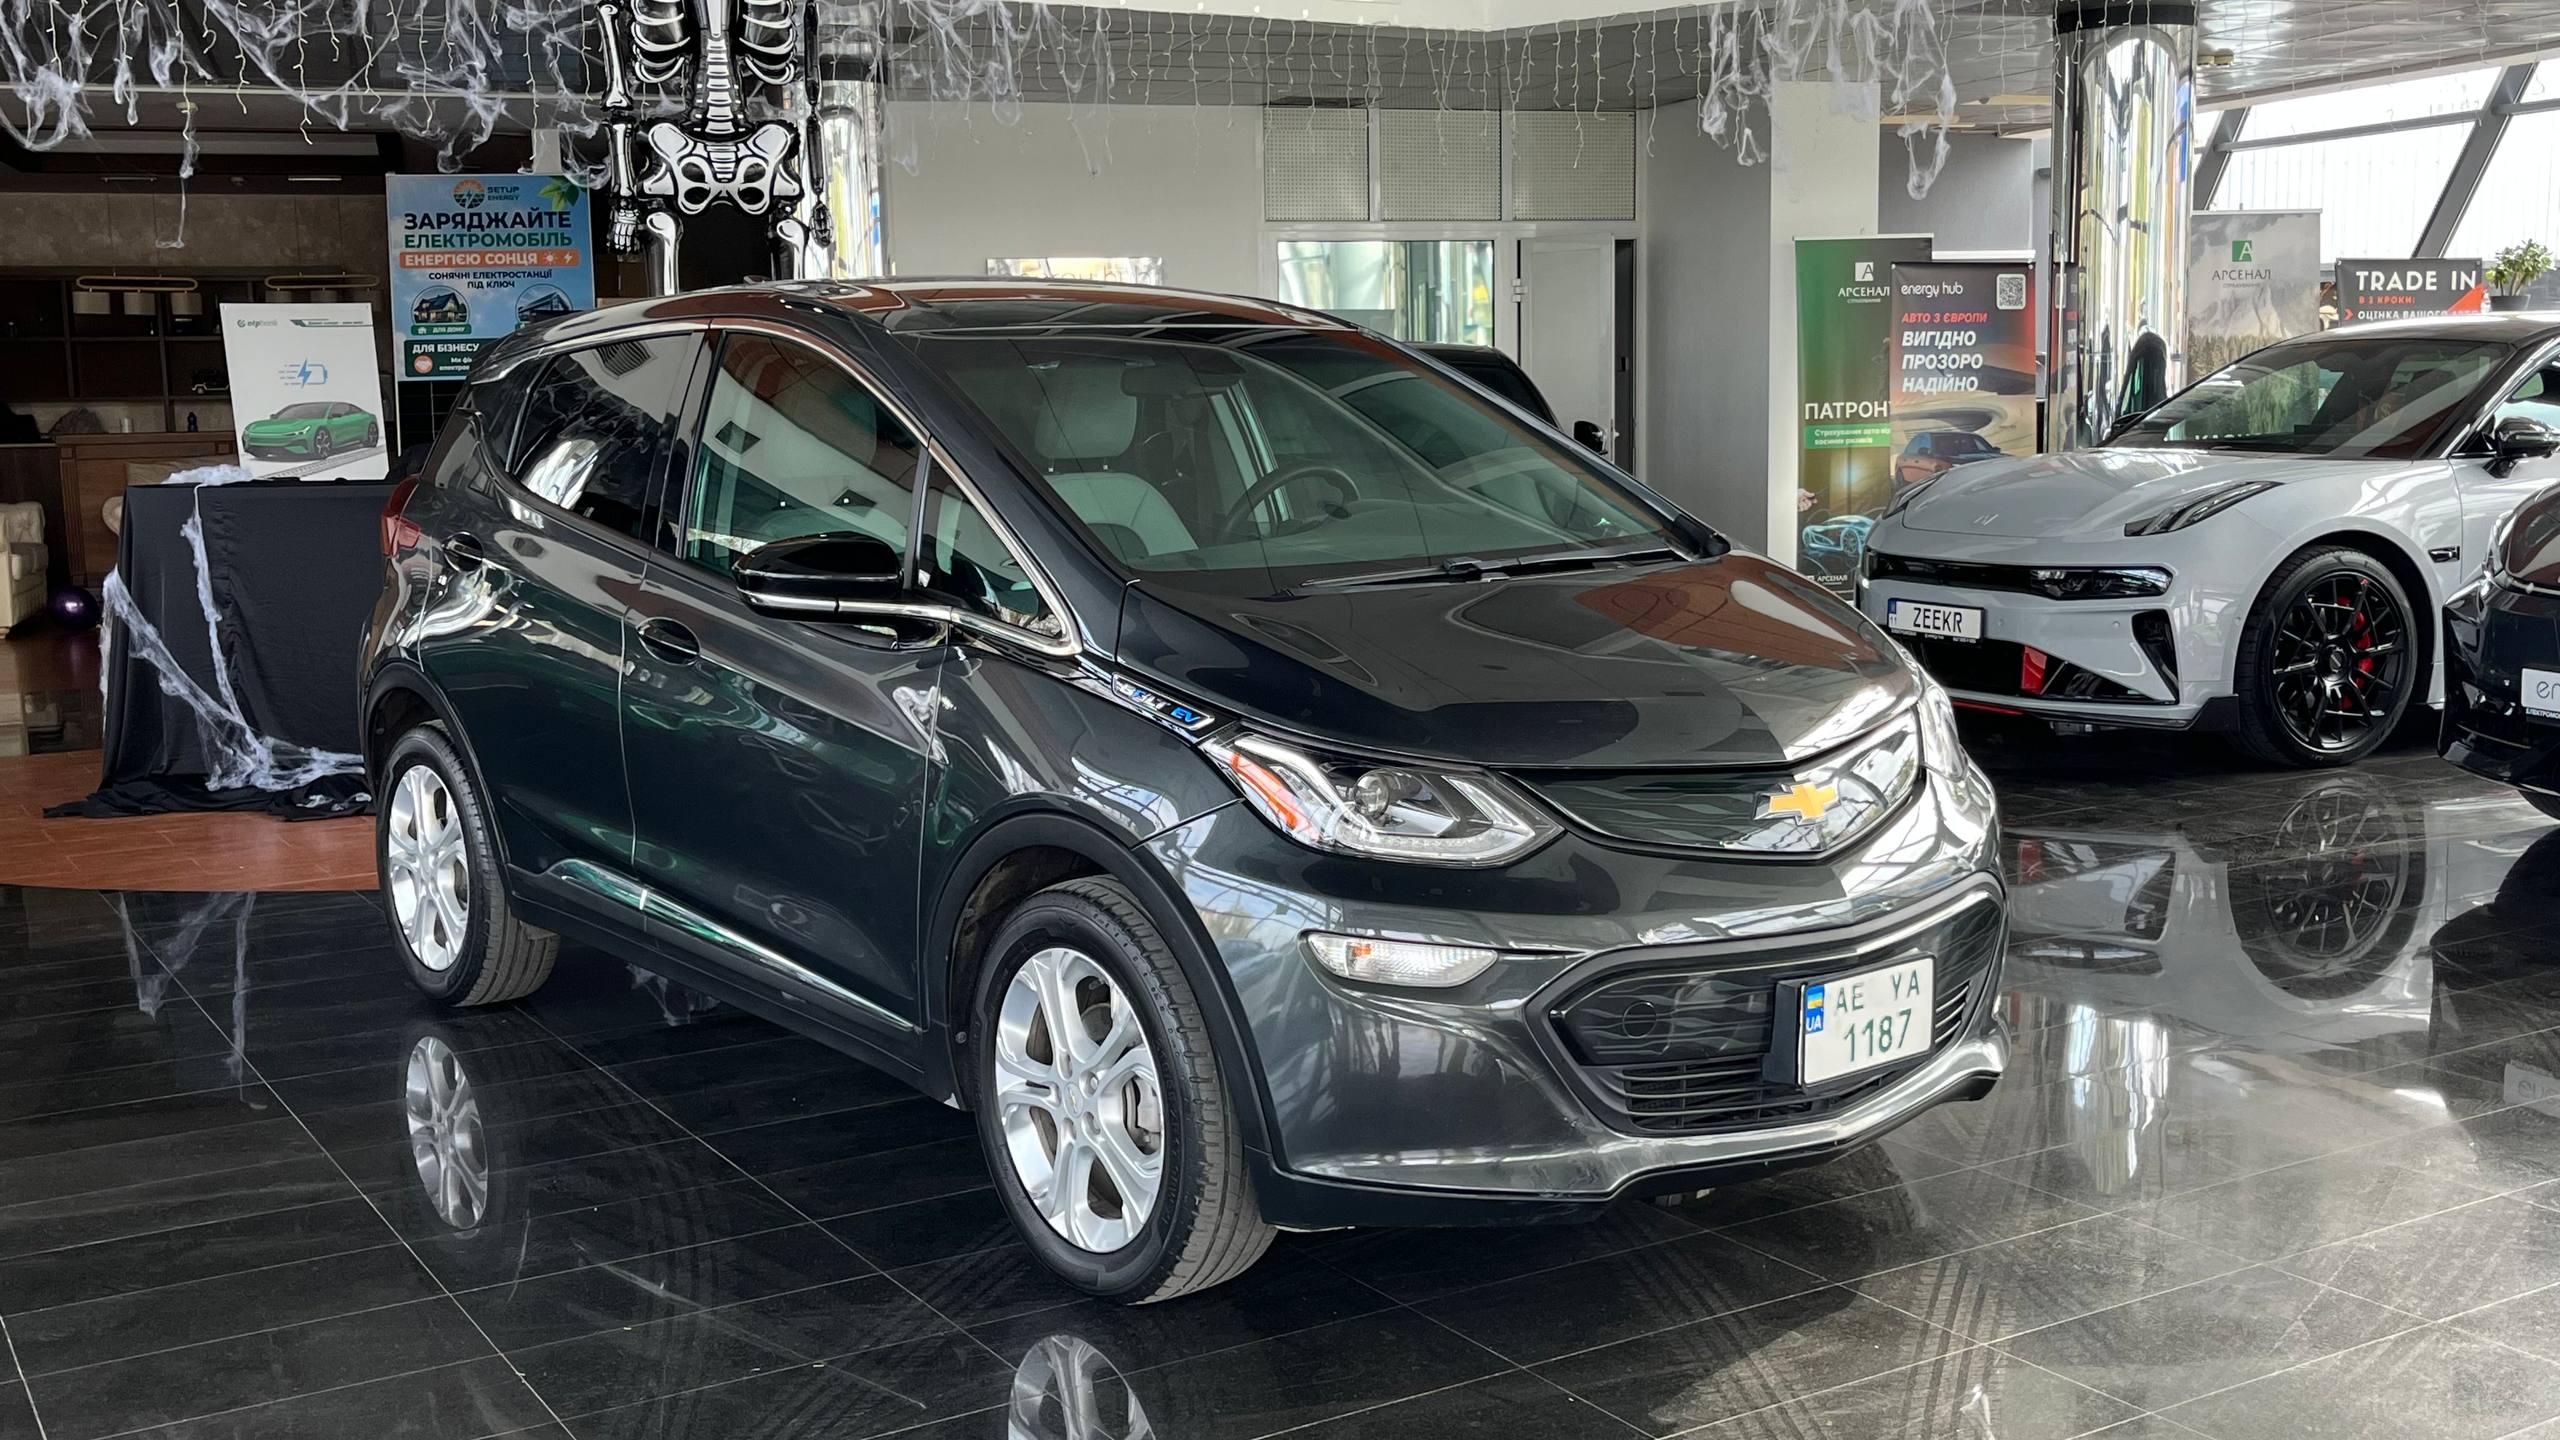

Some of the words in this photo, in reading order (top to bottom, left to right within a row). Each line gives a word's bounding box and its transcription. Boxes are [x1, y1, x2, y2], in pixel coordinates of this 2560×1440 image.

[487, 186, 520, 194] SETUP
[404, 207, 572, 232] ЗАРЯДЖАЙТЕ
[404, 232, 573, 248] ЕЛЕКТРОМОБІЛЬ
[405, 253, 481, 266] ЕНЕРГІЄЮ
[484, 253, 538, 266] СОНЦЯ
[428, 271, 471, 280] СОНЯЧНІ
[472, 269, 553, 279] ЕЛЕКТРОСТАНЦІЇ
[2212, 269, 2272, 281] АРСЕНАЛ
[2356, 270, 2437, 291] TRADE
[2451, 270, 2477, 291] IN
[467, 281, 484, 289] ПІД
[486, 281, 515, 289] КЛЮЧ
[1838, 286, 1891, 297] АРСЕНАЛ
[1901, 284, 1940, 298] energy
[1942, 281, 1964, 295] hub
[1902, 313, 1930, 323] АВТО
[1943, 312, 1988, 322] ЄВРОПИ
[2358, 311, 2400, 321] ОЦІНКА
[1902, 331, 1977, 349] ВИГІДНО
[412, 344, 435, 354] ДЛЯ
[437, 343, 480, 353] БІЗНЕСУ
[1902, 354, 1984, 370] ПРОЗОРО
[1902, 374, 1979, 394] НАДІЙНО
[1805, 401, 1891, 420] ПАТРОН
[1913, 607, 1963, 633] ZEEKR
[1170, 706, 1201, 723] EV
[1835, 981, 1865, 1014] AE
[1891, 969, 1920, 1001] YA
[1806, 1014, 1822, 1031] UA
[1844, 1008, 1912, 1062] 1187
